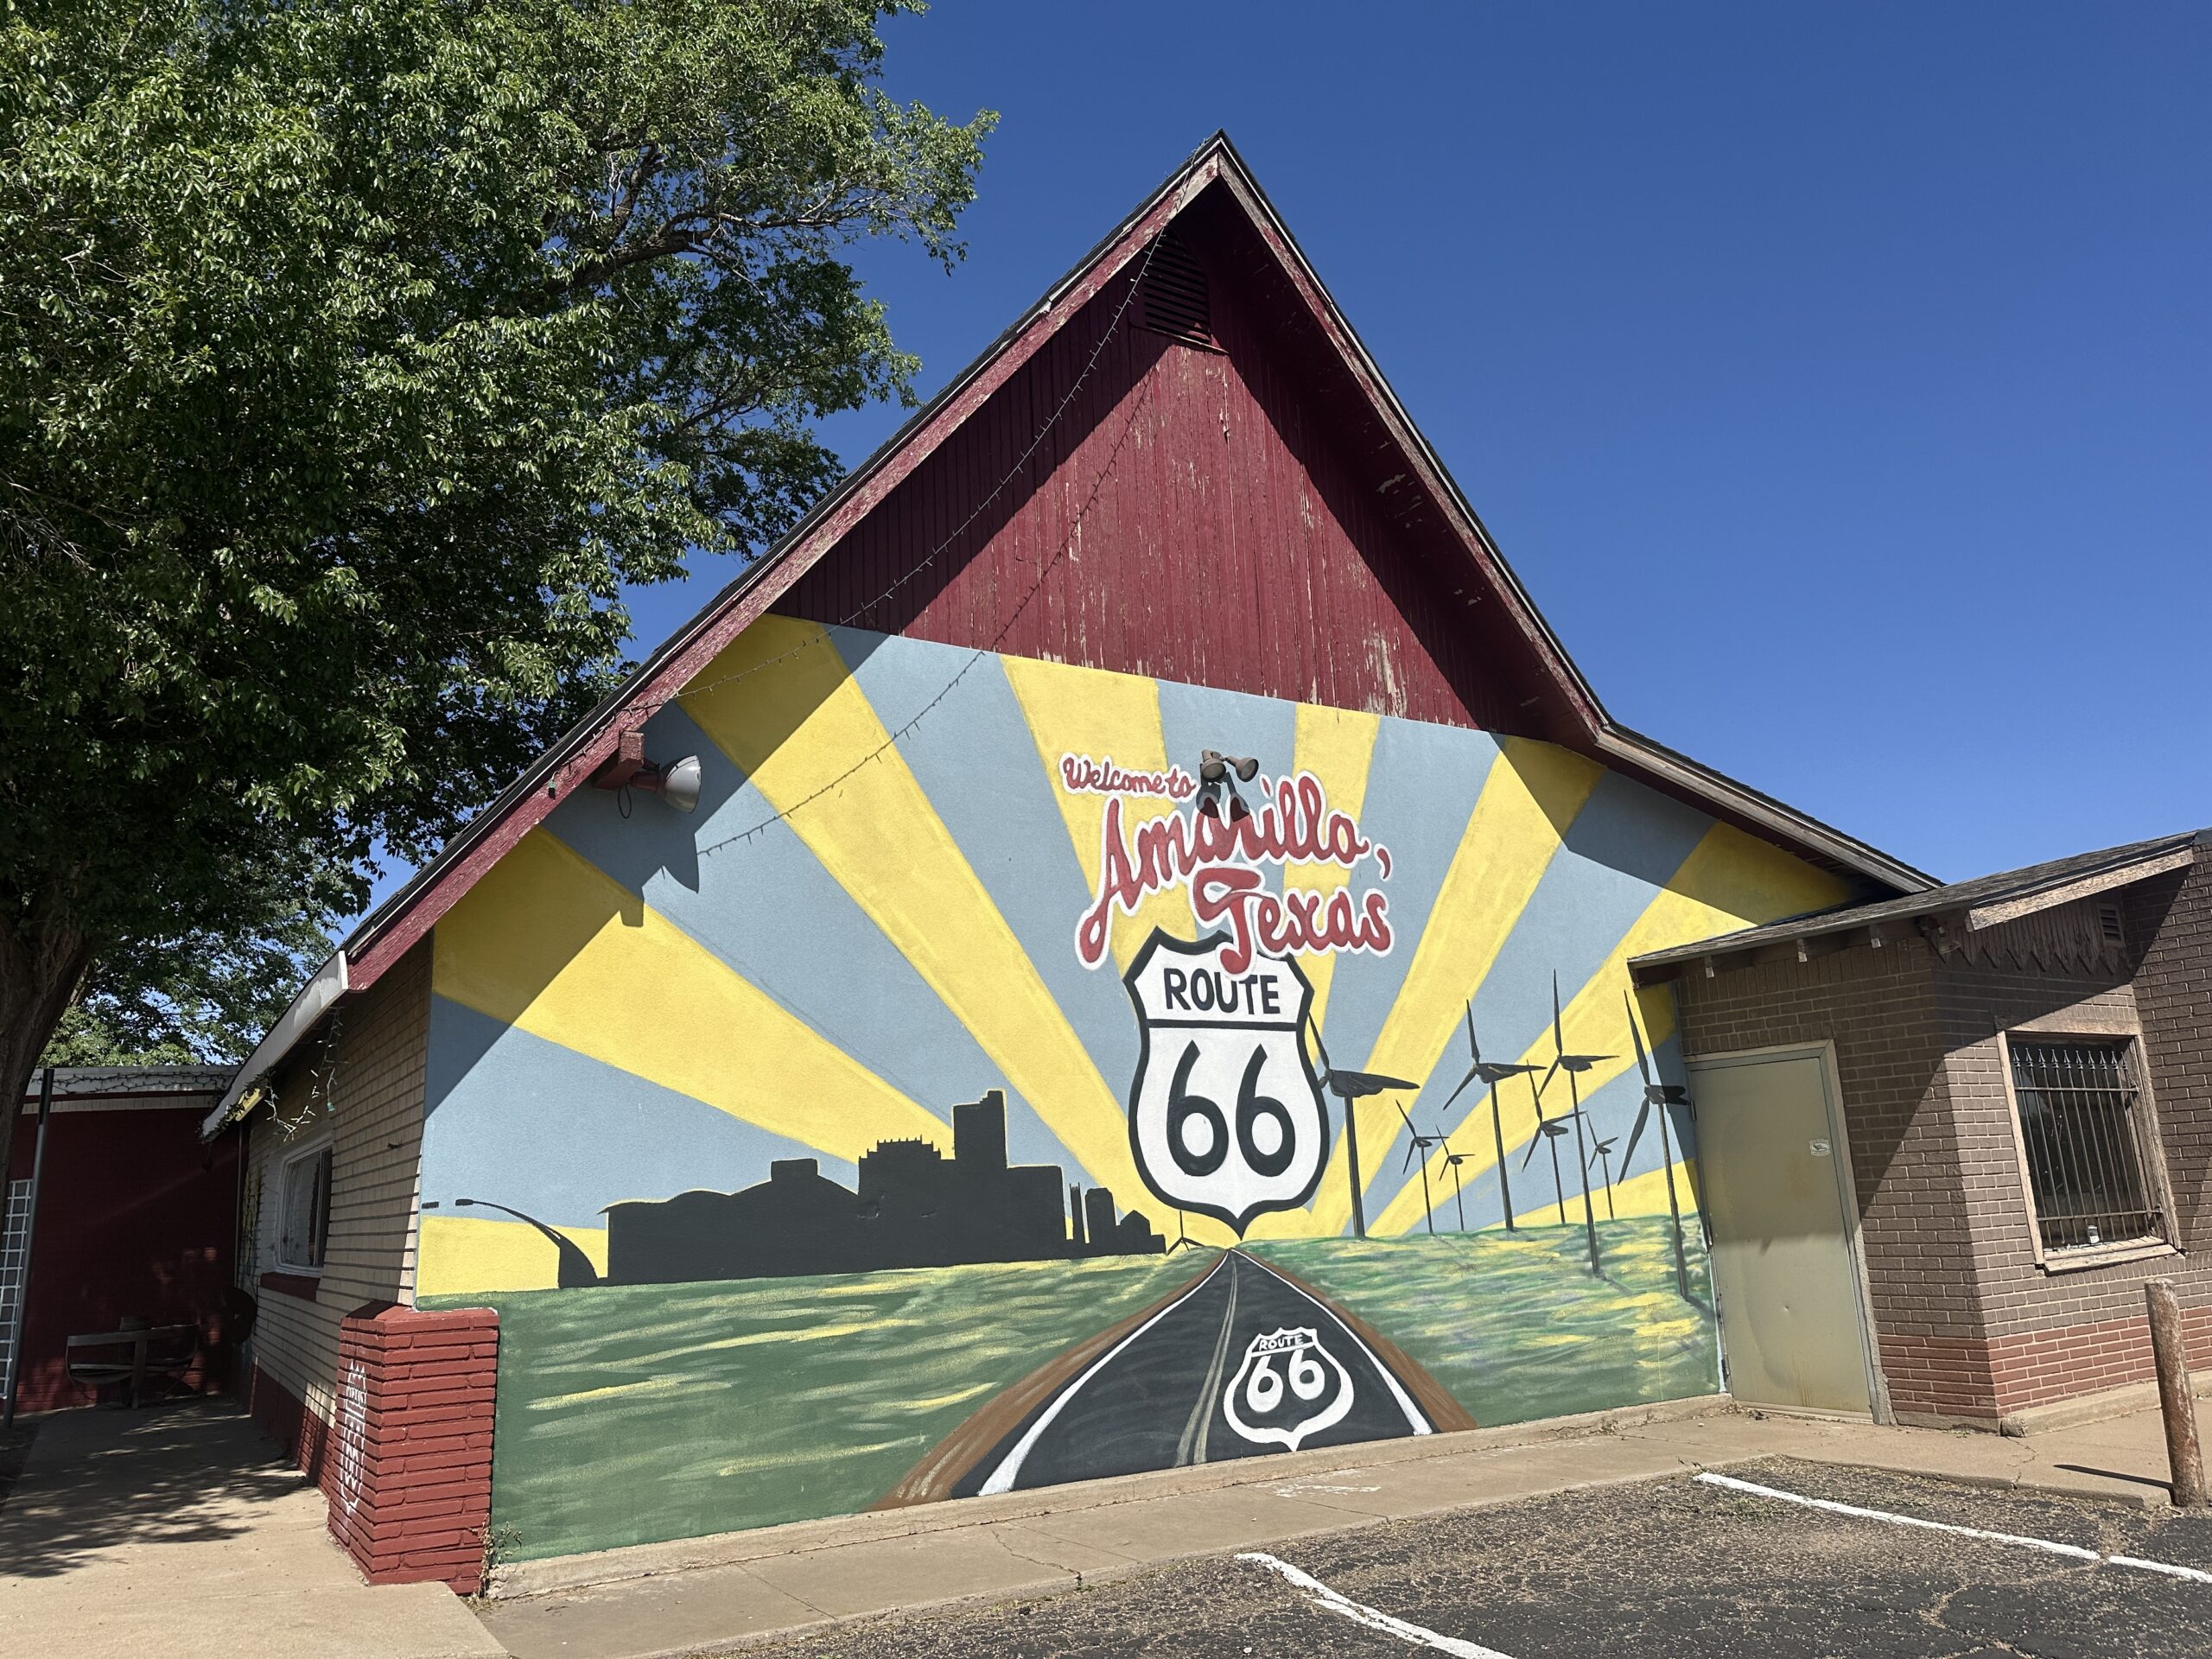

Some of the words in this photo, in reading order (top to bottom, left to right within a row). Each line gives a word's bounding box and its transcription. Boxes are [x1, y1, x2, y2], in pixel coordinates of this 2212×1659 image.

[1063, 757, 1166, 794] Welcome
[1166, 768, 1197, 798] to
[1080, 776, 1391, 963] Amarillo,
[1193, 868, 1391, 975] Texas
[1164, 968, 1281, 1015] ROUTE
[1166, 1040, 1295, 1177] 66
[1259, 1335, 1304, 1351] ROUTE
[1246, 1349, 1325, 1413] 66
